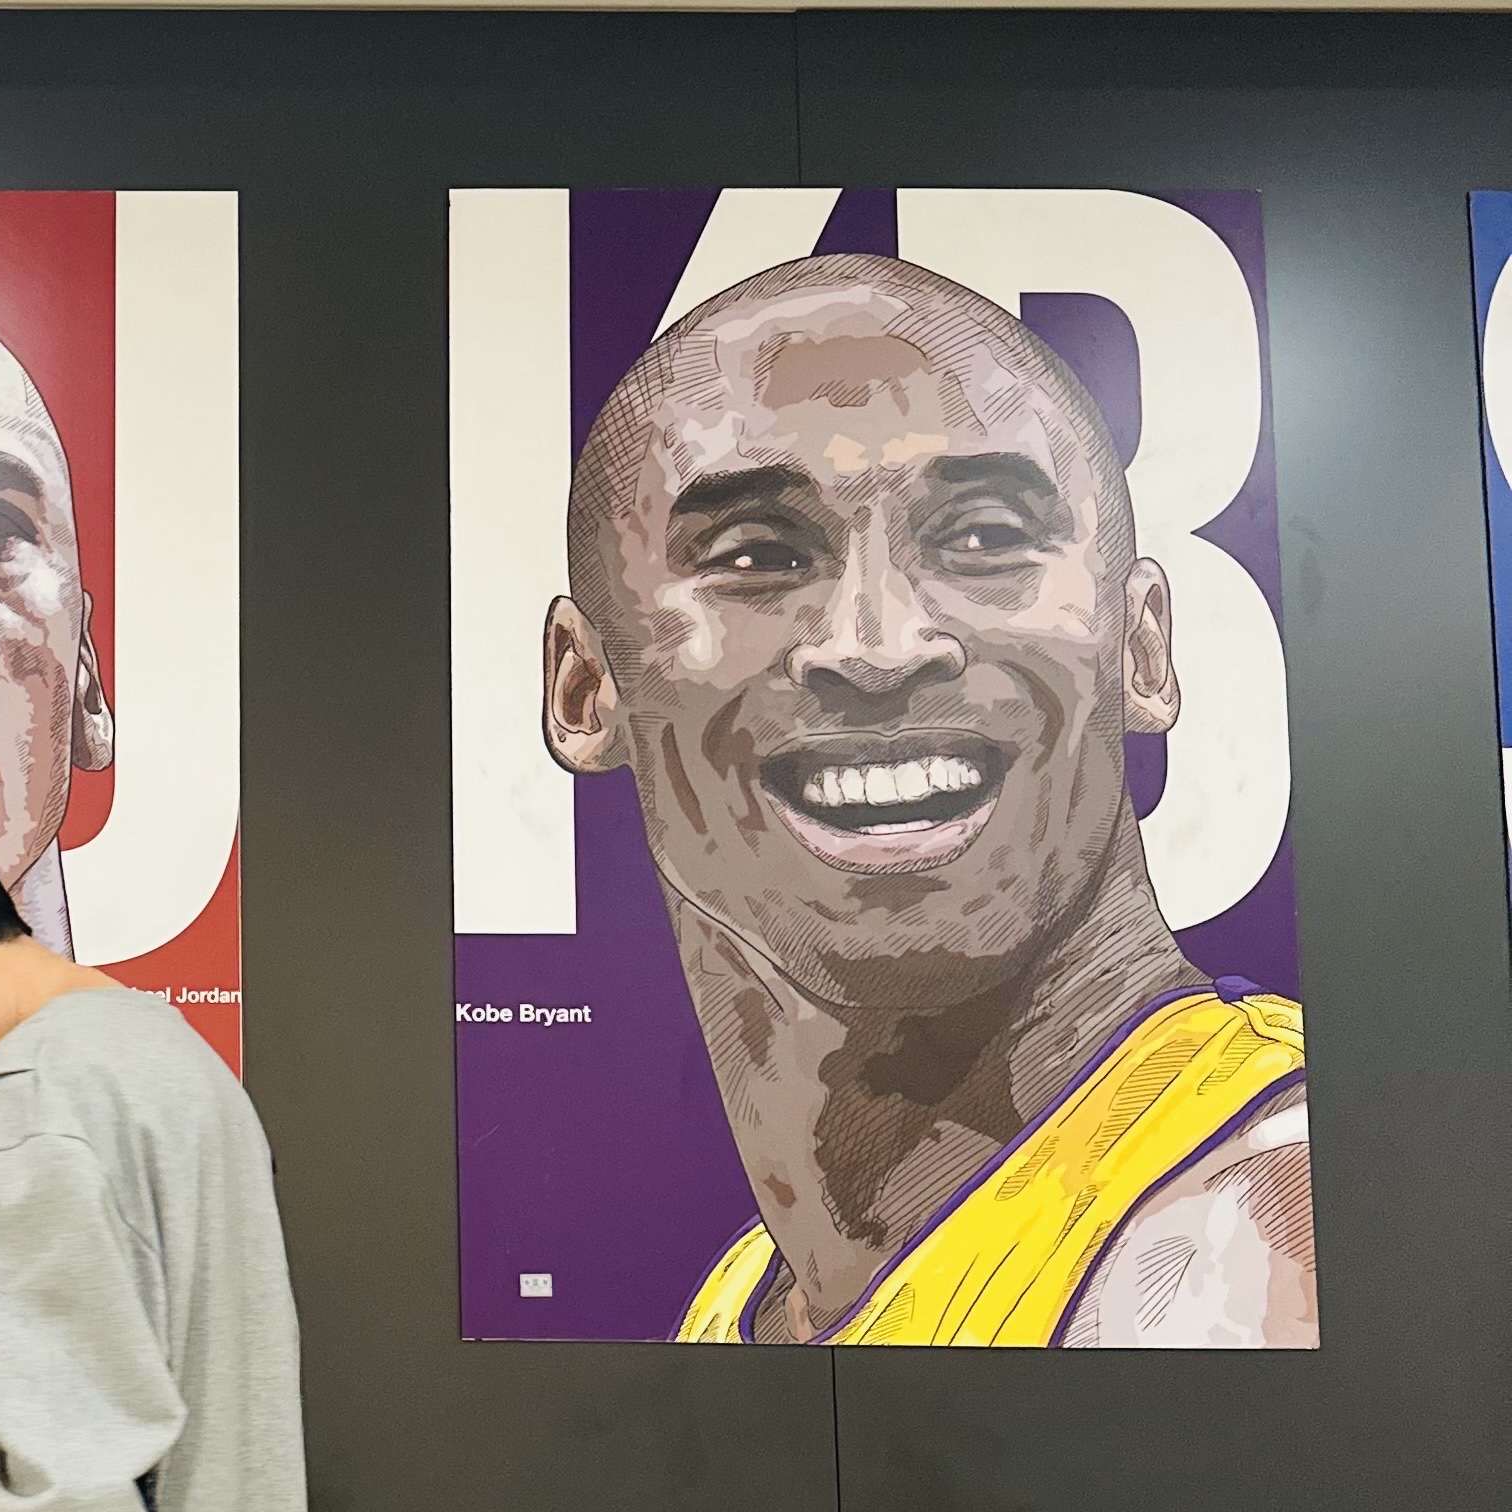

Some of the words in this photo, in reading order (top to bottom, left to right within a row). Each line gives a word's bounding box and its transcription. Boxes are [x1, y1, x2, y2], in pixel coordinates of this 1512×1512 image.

[175, 986, 241, 1004] Jordan
[455, 1003, 513, 1023] Kobe
[519, 1003, 592, 1026] Bryant
